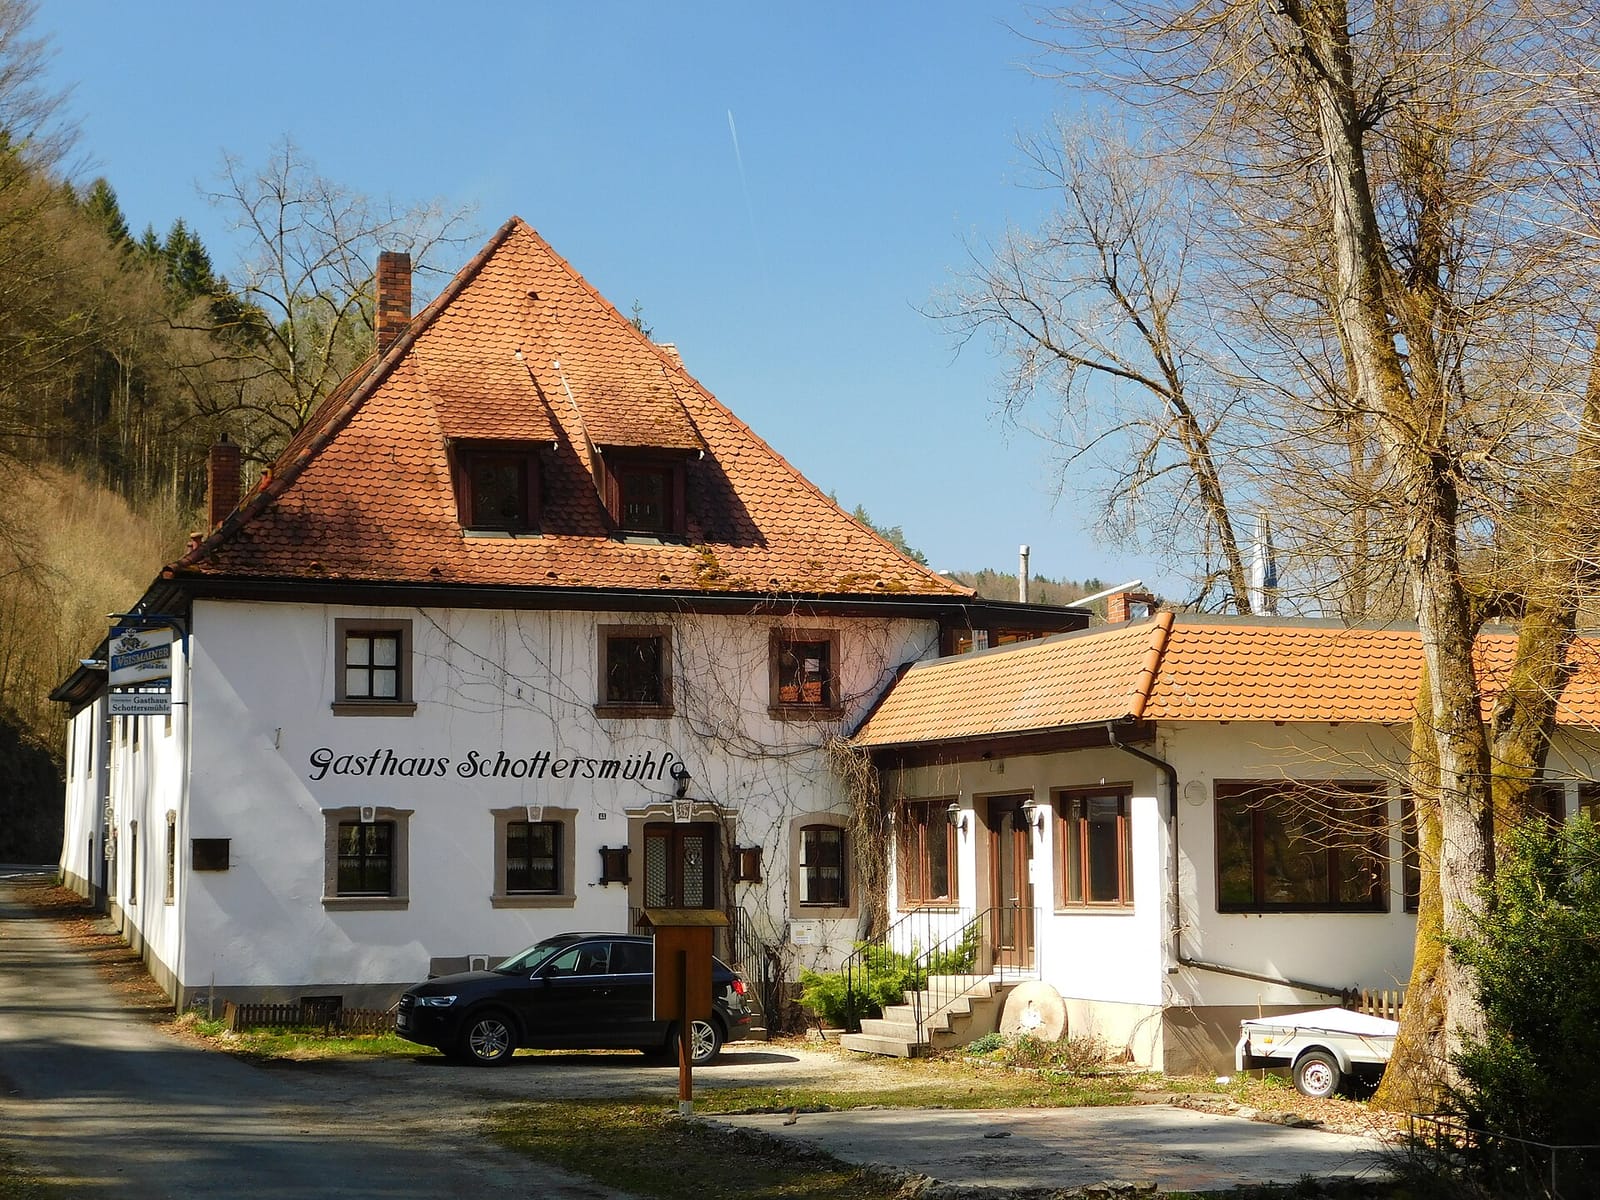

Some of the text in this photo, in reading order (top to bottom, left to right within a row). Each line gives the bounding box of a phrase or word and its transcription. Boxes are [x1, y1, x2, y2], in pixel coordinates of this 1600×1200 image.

[133, 696, 168, 704] Gasthaus
[112, 704, 170, 712] Schottersmühle
[309, 748, 686, 781] Gasthaus Schottersmühle
